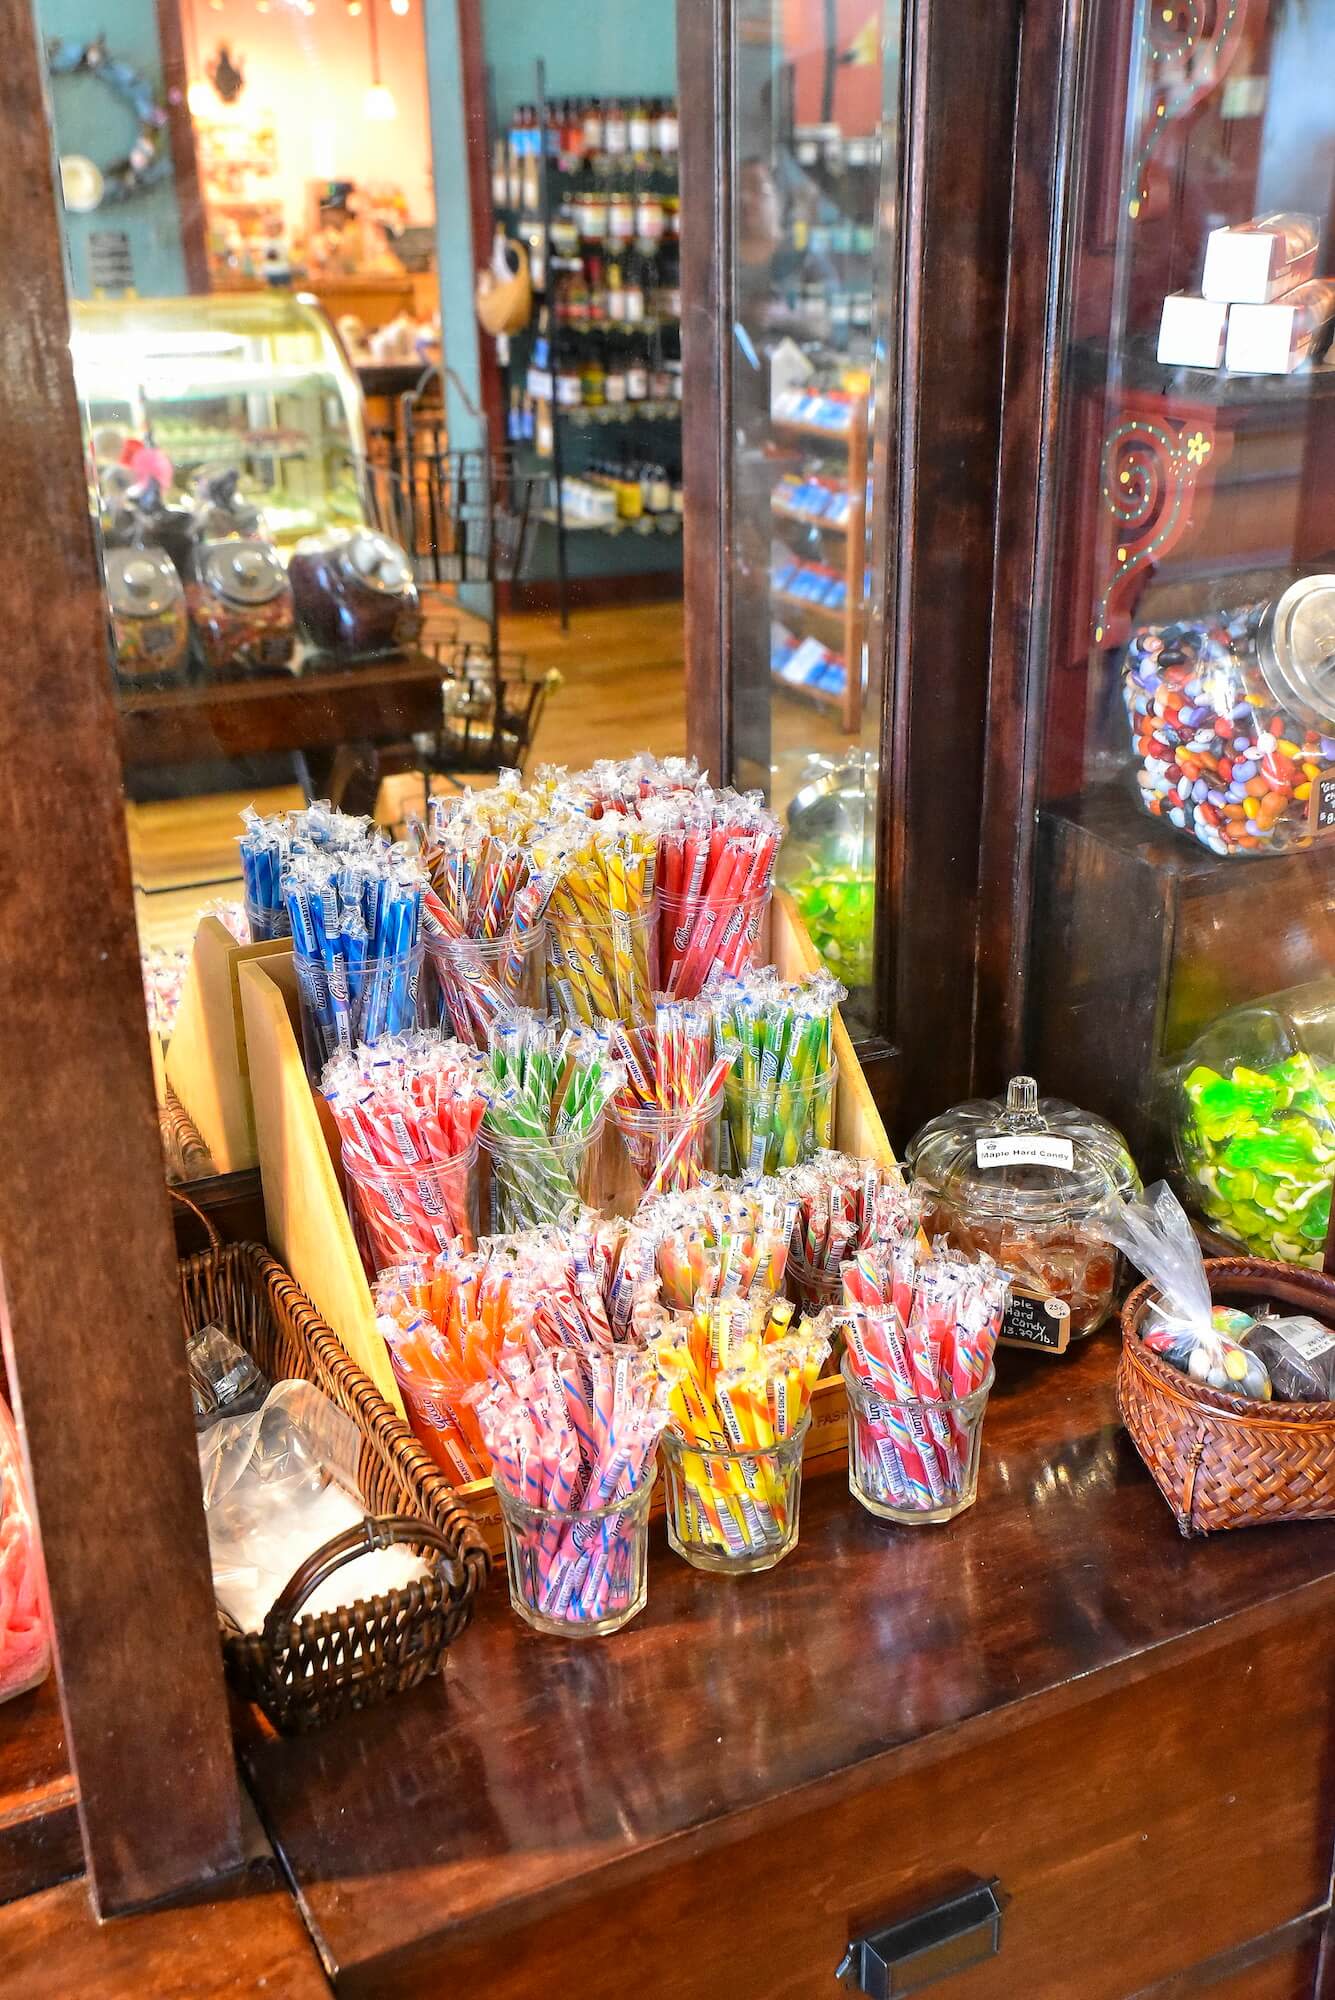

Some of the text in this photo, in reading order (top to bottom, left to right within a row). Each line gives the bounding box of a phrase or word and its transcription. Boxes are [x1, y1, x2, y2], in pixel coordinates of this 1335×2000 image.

[746, 851, 758, 875] CHERRY
[298, 895, 312, 936] BLUEBERRY
[615, 1034, 643, 1084] ISLAND PUNCH
[982, 1150, 1010, 1159] Maple
[1040, 1150, 1069, 1160] Candy
[864, 1178, 874, 1223] WATERMELON
[1011, 1318, 1046, 1335] Candy
[888, 1331, 907, 1380] PASSION FRUIT
[728, 1419, 740, 1440] CREAM
